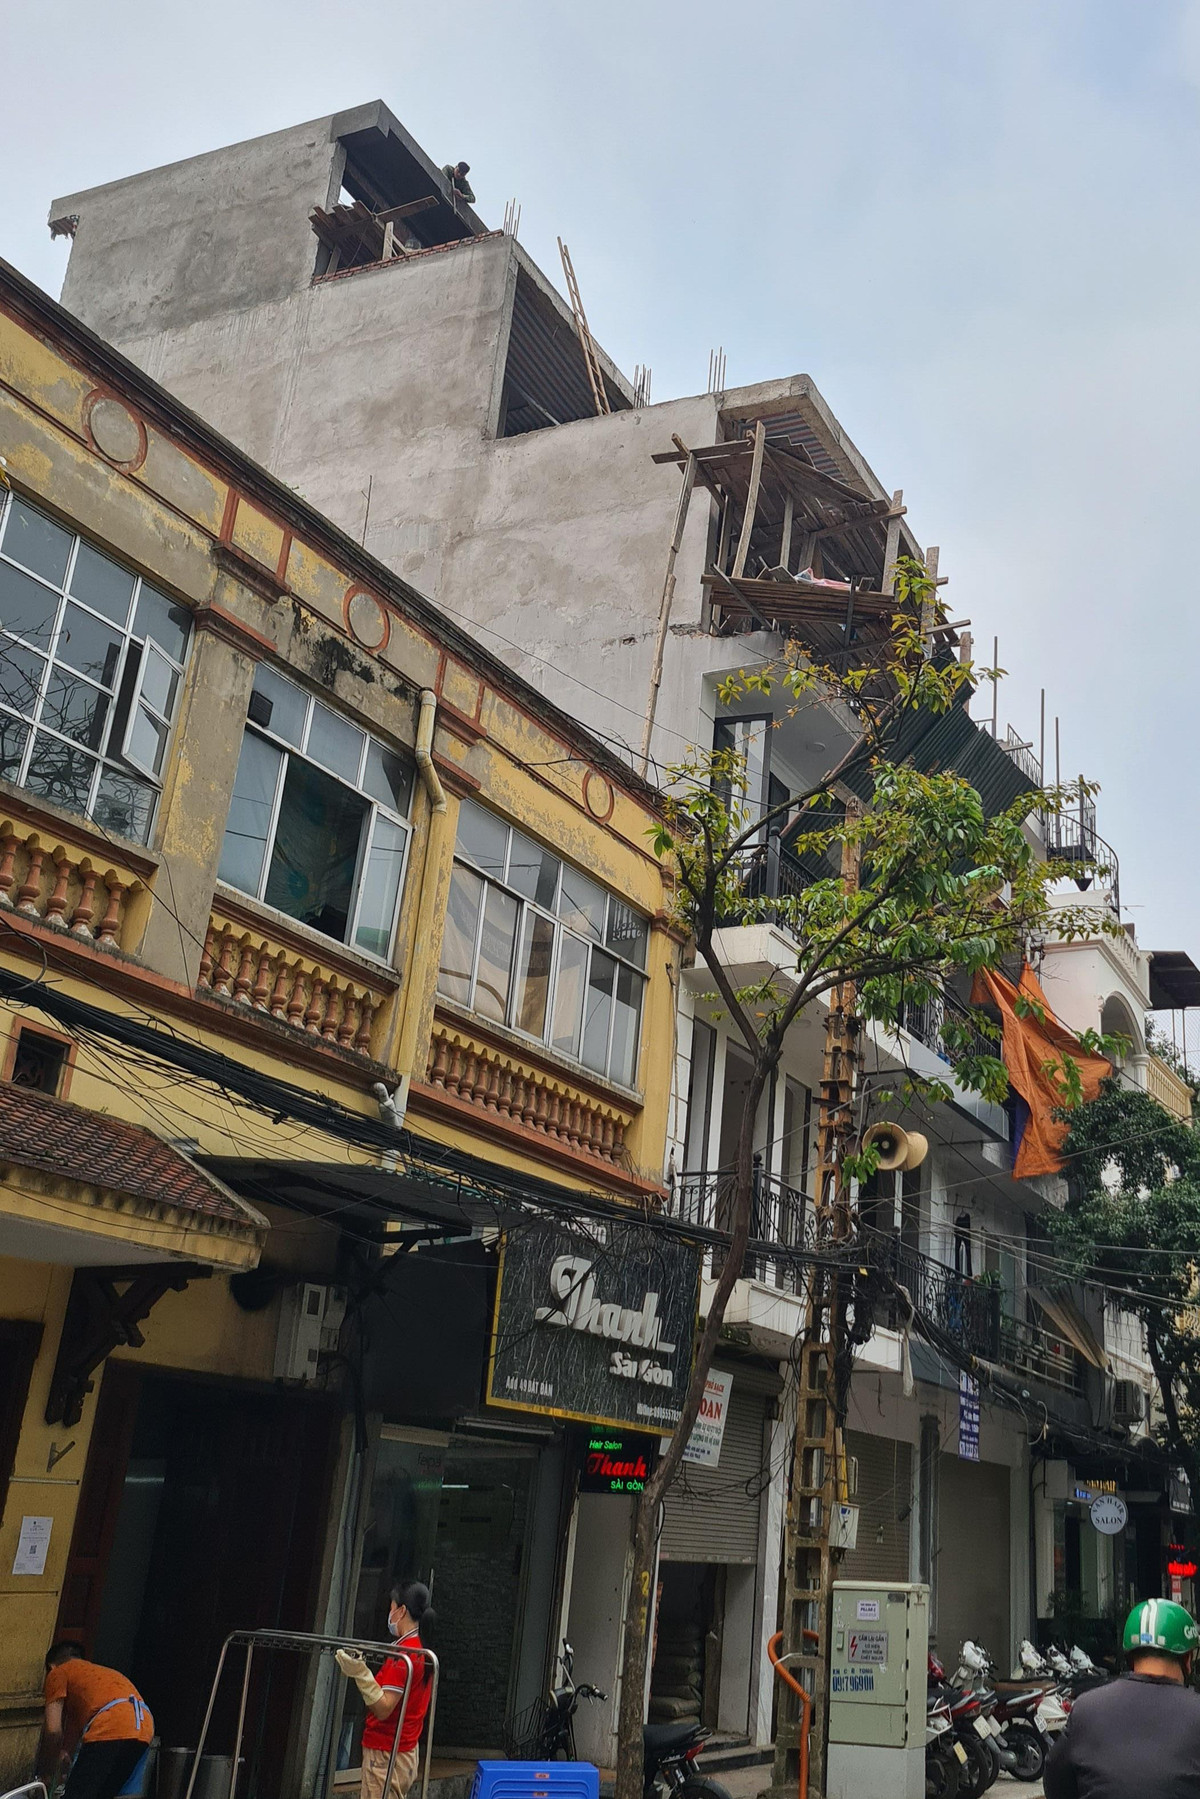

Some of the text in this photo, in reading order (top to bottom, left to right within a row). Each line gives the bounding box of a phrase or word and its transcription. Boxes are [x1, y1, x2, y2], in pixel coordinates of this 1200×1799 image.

[535, 1254, 675, 1353] Thanh
[589, 1440, 603, 1449] Hair
[586, 1453, 646, 1477] Thanh
[1096, 1516, 1122, 1524] SALON
